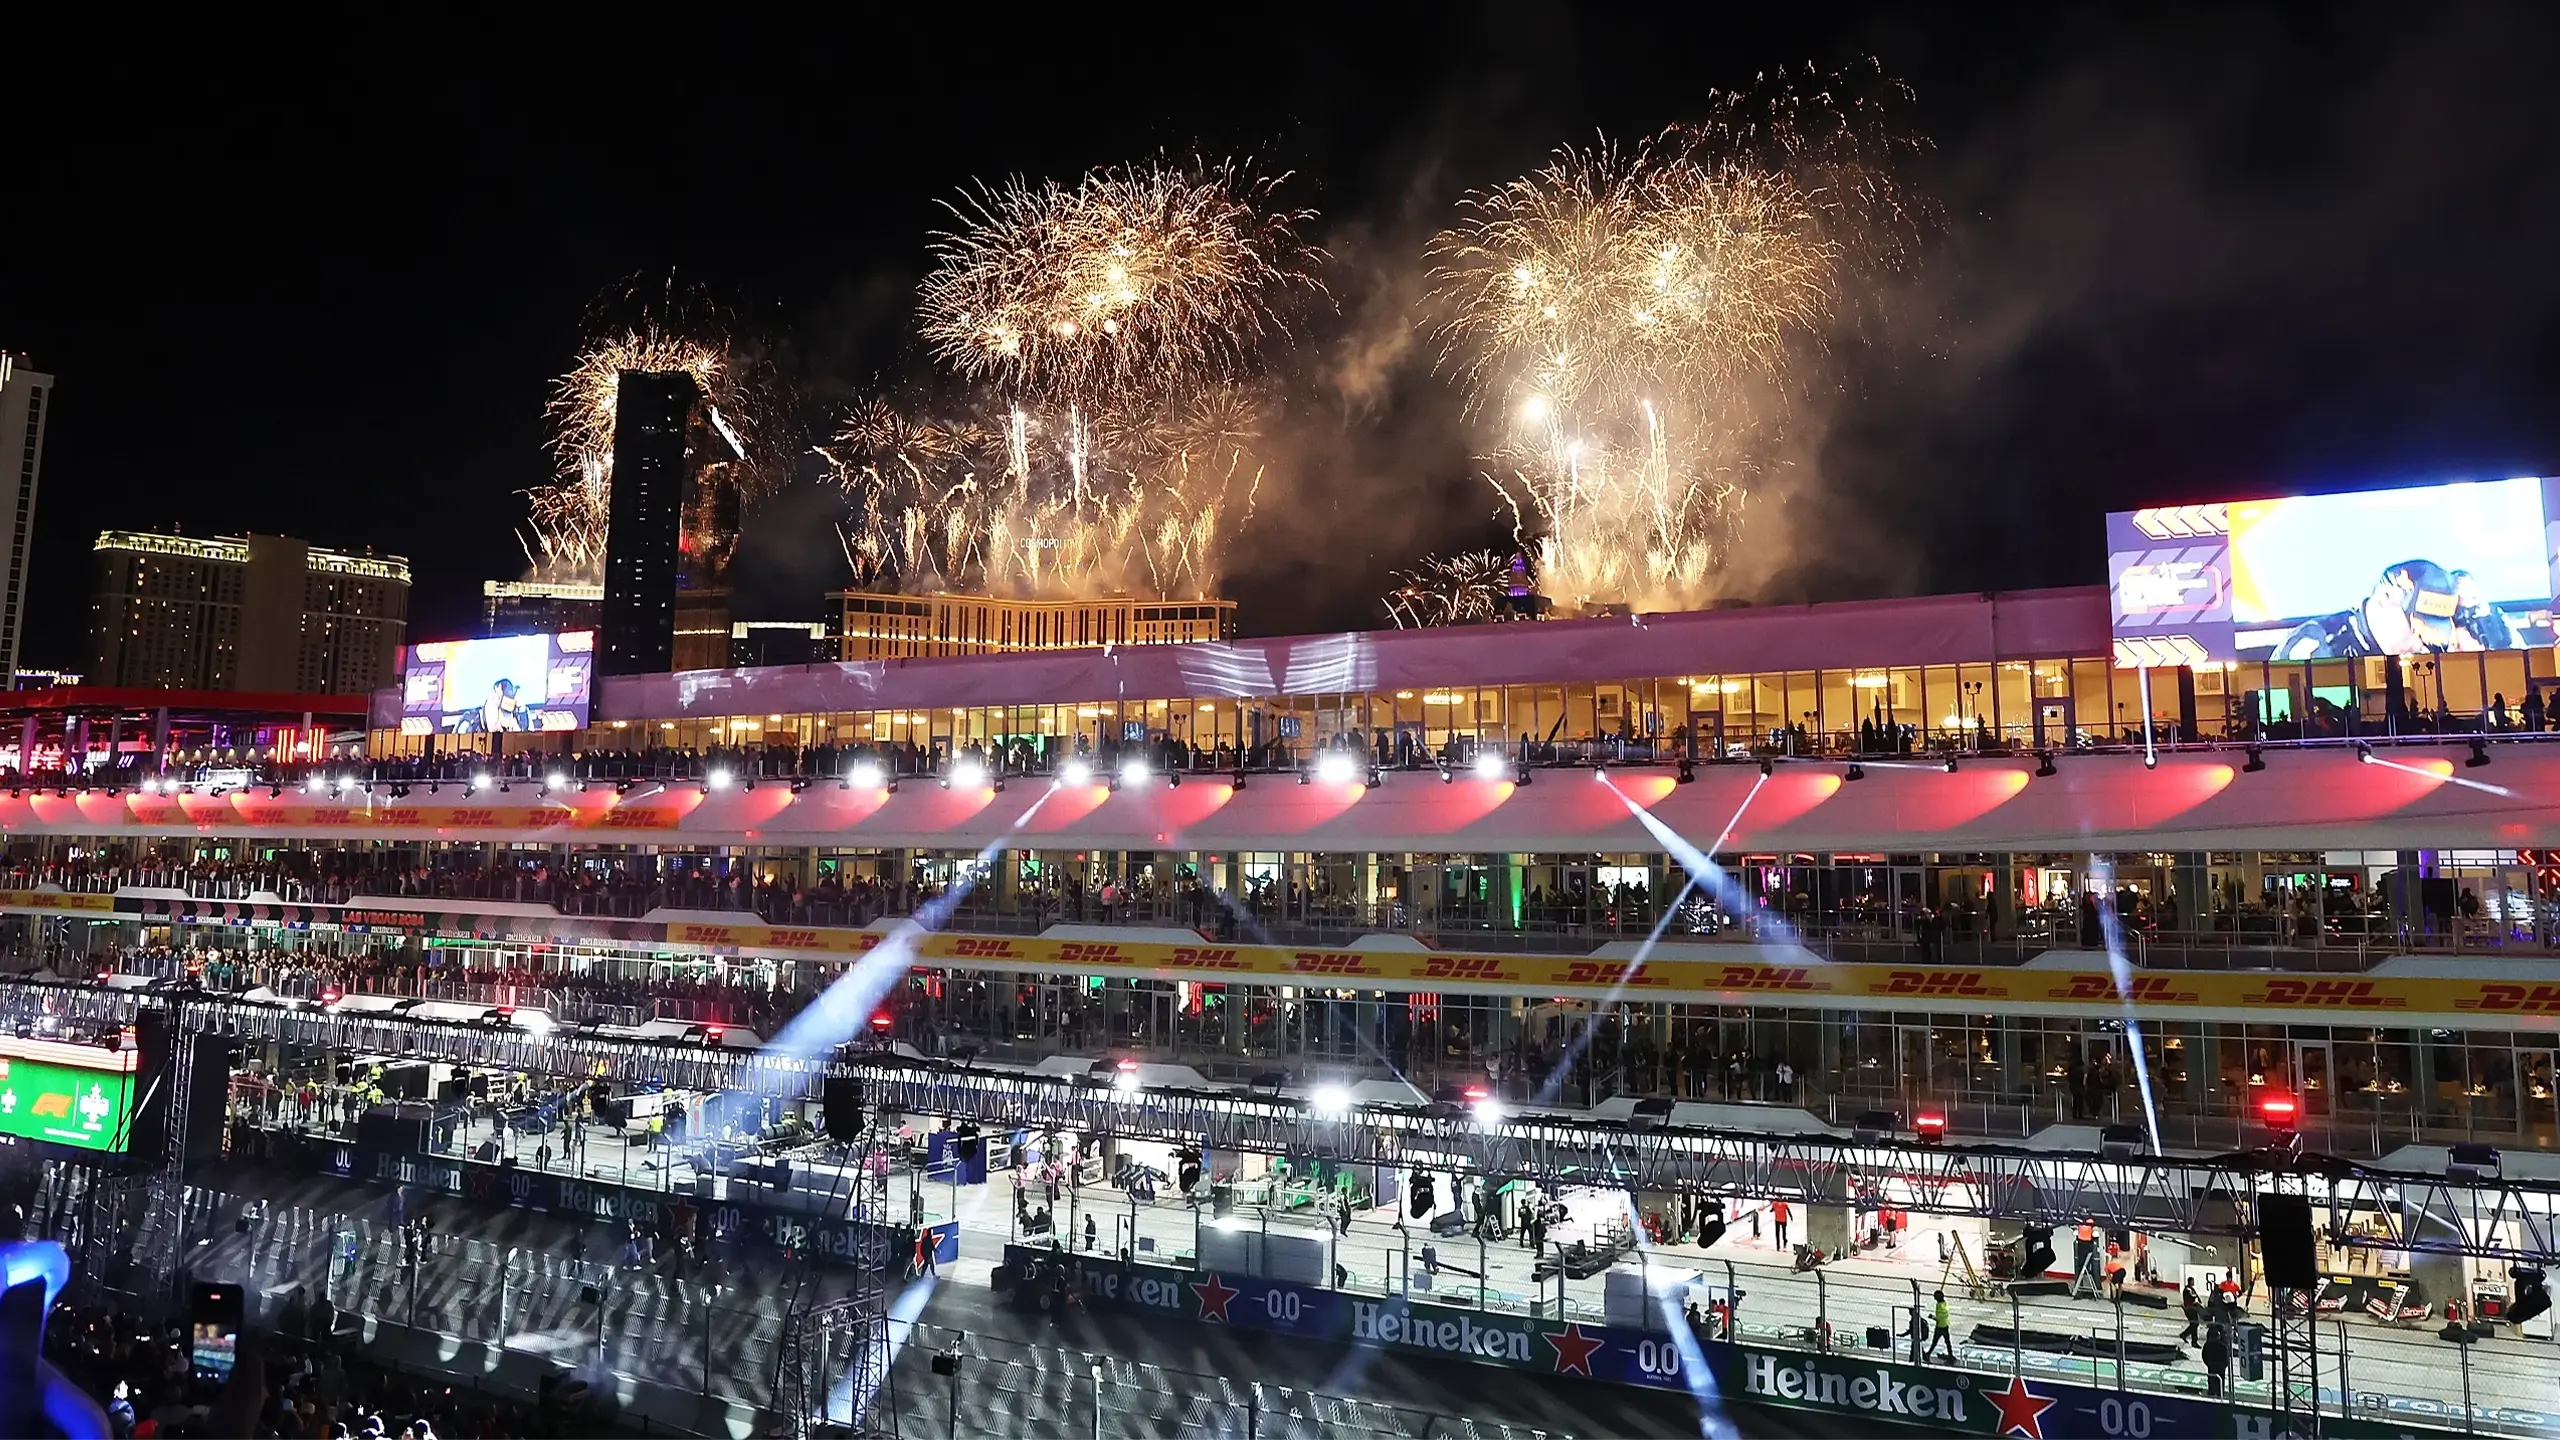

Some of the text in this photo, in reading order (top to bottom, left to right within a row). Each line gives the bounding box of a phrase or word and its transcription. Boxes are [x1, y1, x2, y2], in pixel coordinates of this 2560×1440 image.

[314, 810, 351, 824] DHL
[451, 810, 494, 825] DHL
[610, 810, 658, 827] DHL
[342, 911, 361, 923] LAS
[363, 912, 397, 926] VEGAS
[686, 926, 733, 942] DHL
[768, 931, 819, 947] DHL
[954, 939, 1014, 957] DHL
[1059, 944, 1122, 963] DHL
[1173, 949, 1240, 968] DHL
[1295, 954, 1367, 974] DHL
[1425, 958, 1504, 980] DHL
[1568, 963, 1651, 984] DHL
[1721, 967, 1813, 989] DHL
[1888, 971, 1987, 995] DHL
[2068, 976, 2177, 999] DHL
[2265, 980, 2375, 1006] DHL
[2479, 985, 2560, 1010] DH
[376, 1151, 461, 1190] Heineken
[510, 1173, 531, 1197] 0.0
[558, 1180, 659, 1224] Heineken
[1267, 1288, 1300, 1321] 0.0
[1352, 1300, 1532, 1362] Heineken
[1638, 1339, 1679, 1375] 0.0
[1743, 1352, 1968, 1422] Heineken
[2100, 1397, 2152, 1438] 0.0
